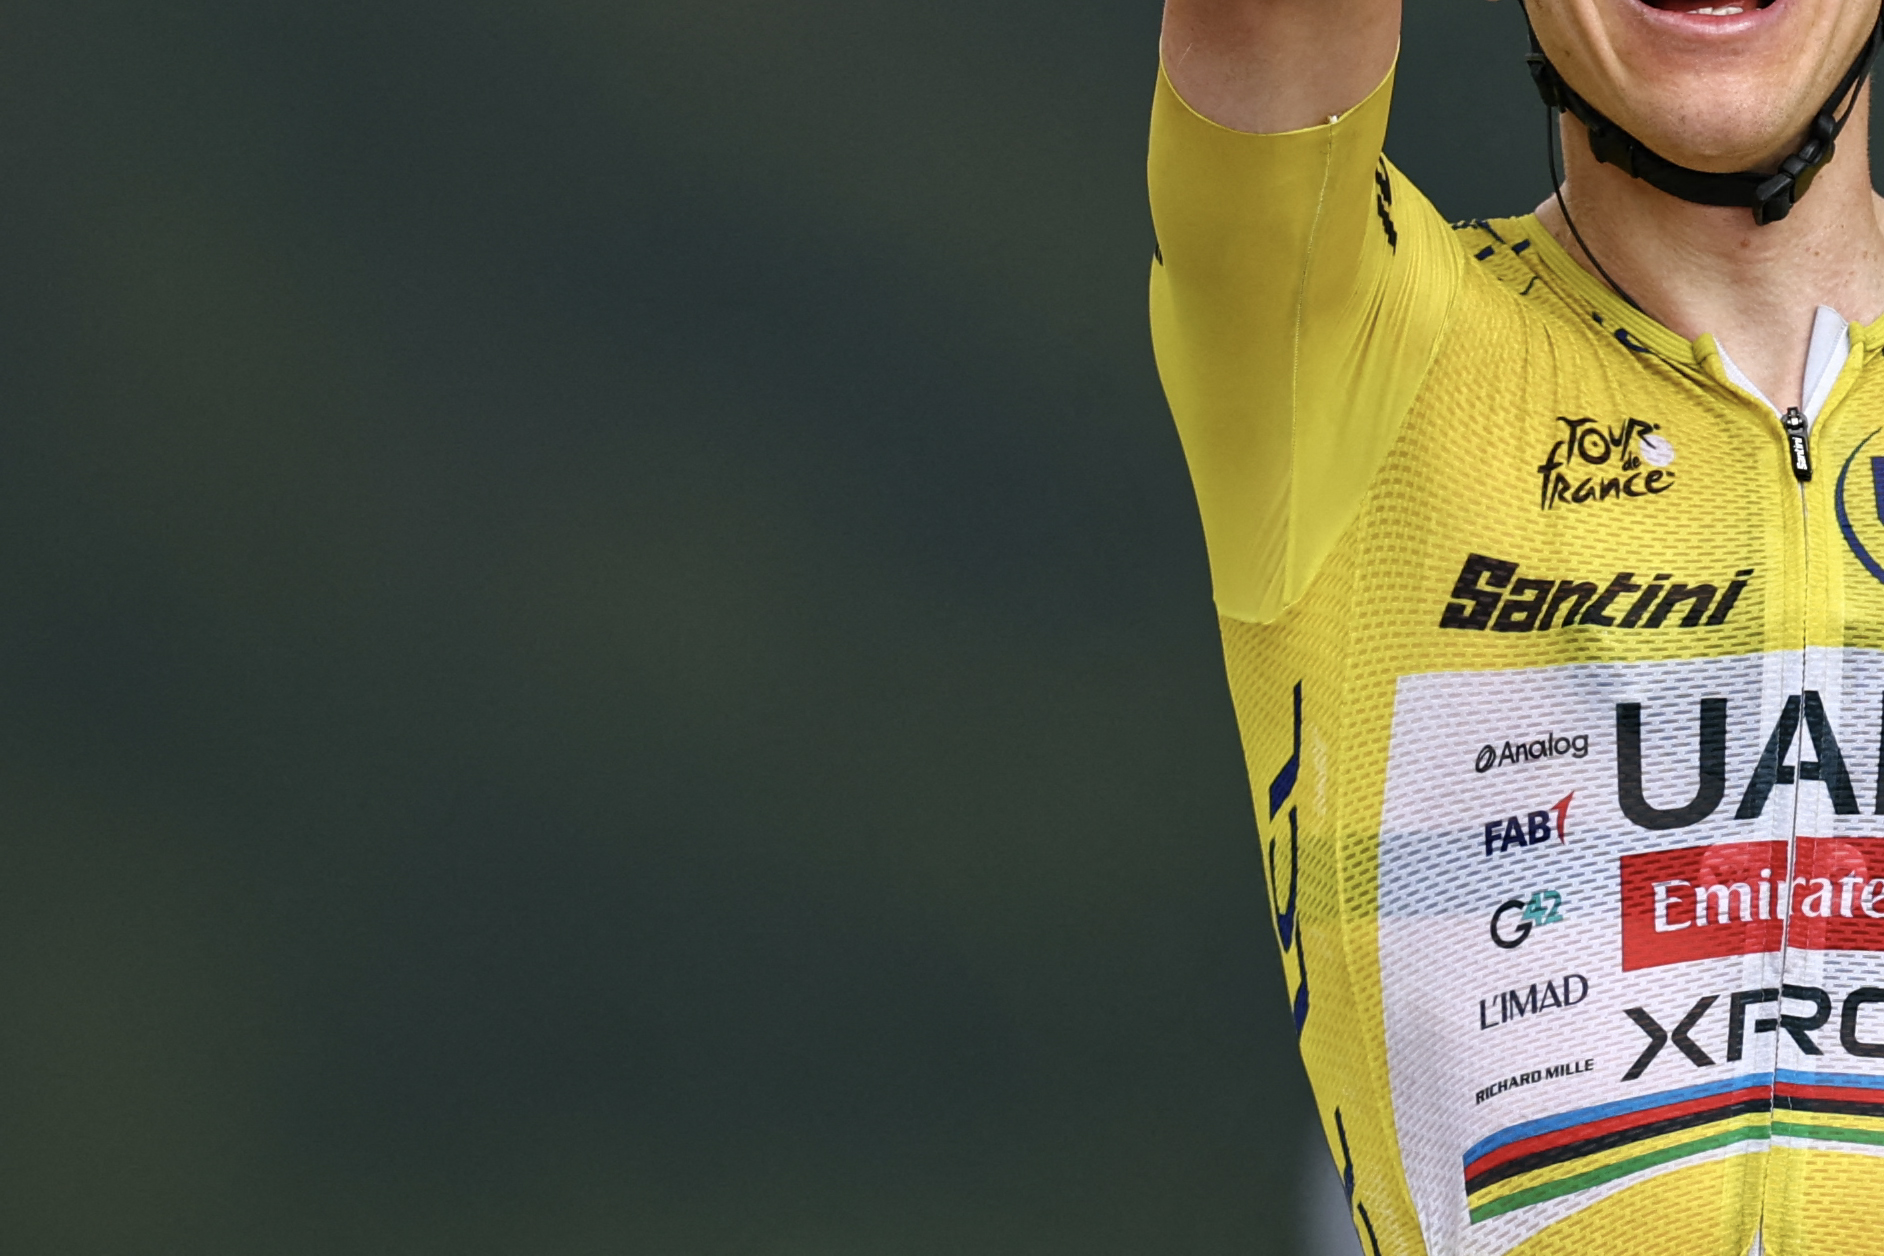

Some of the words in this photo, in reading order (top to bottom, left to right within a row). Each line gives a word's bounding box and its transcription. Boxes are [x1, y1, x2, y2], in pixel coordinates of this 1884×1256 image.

[1621, 451, 1642, 472] de
[1438, 553, 1755, 633] Santini
[1497, 732, 1589, 768] Analog
[1489, 889, 1565, 950] G42
[1475, 1069, 1542, 1105] RICHARD
[1545, 1058, 1595, 1081] MILLE
